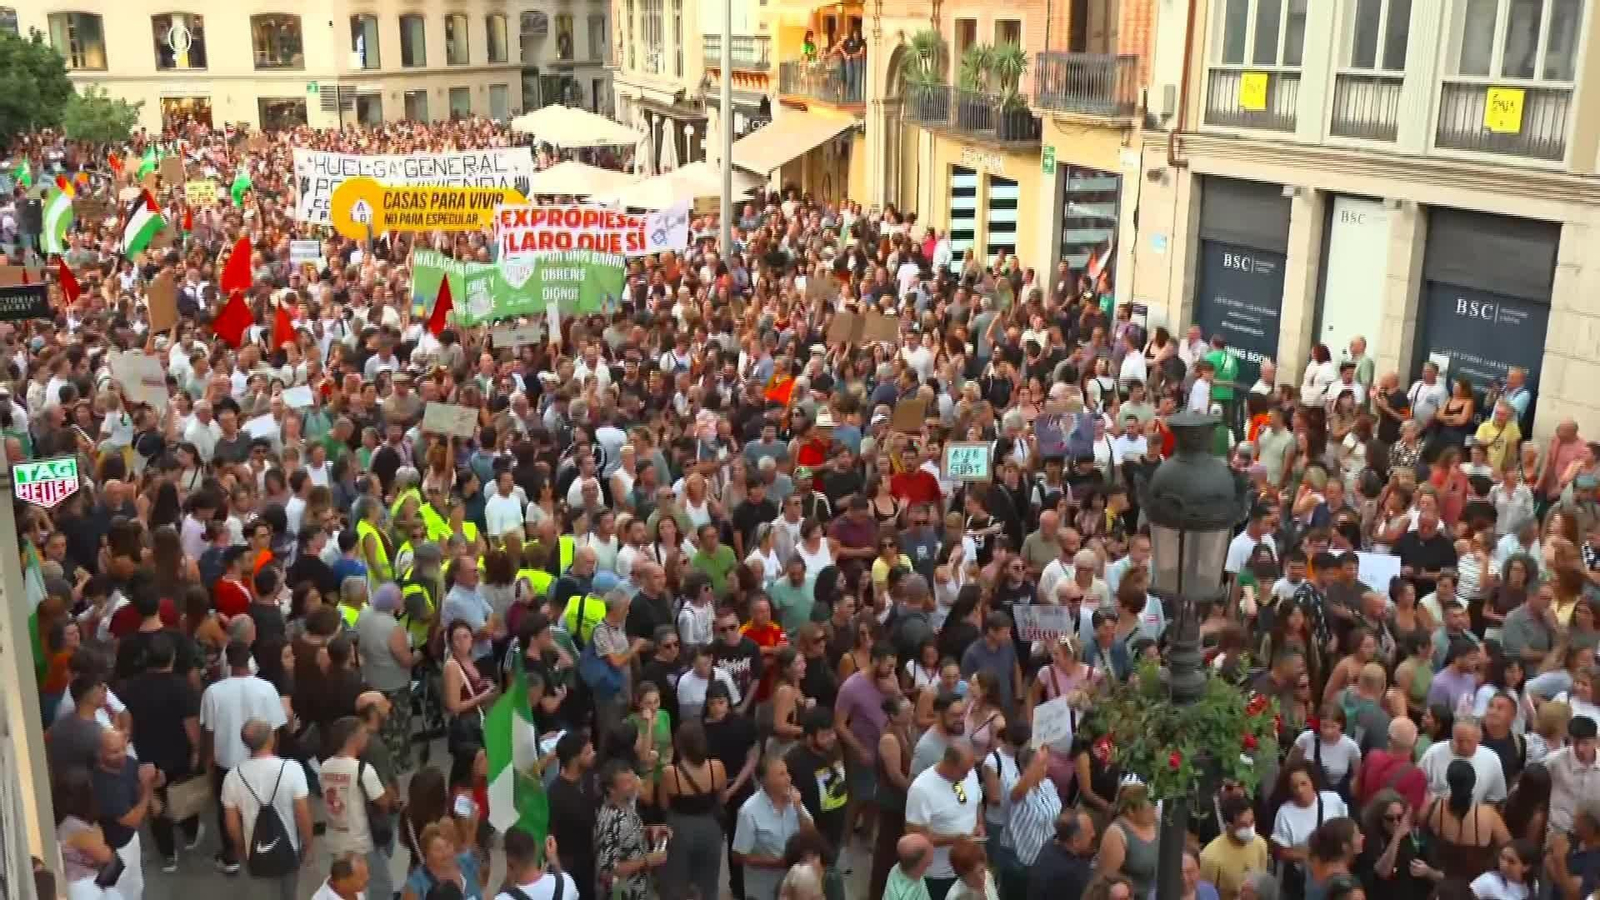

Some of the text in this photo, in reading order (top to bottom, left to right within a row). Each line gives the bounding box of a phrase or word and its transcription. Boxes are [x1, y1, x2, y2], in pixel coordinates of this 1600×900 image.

[314, 154, 507, 178] HUELGA GENERAL
[383, 191, 427, 209] CASAS
[430, 191, 465, 209] PARA
[384, 213, 397, 225] NO
[400, 213, 423, 226] PARA
[425, 212, 478, 226] ESPECULAR
[1223, 252, 1251, 272] BSC
[1456, 298, 1495, 320] BSC
[17, 461, 75, 482] TAG
[18, 480, 77, 503] HEUER
